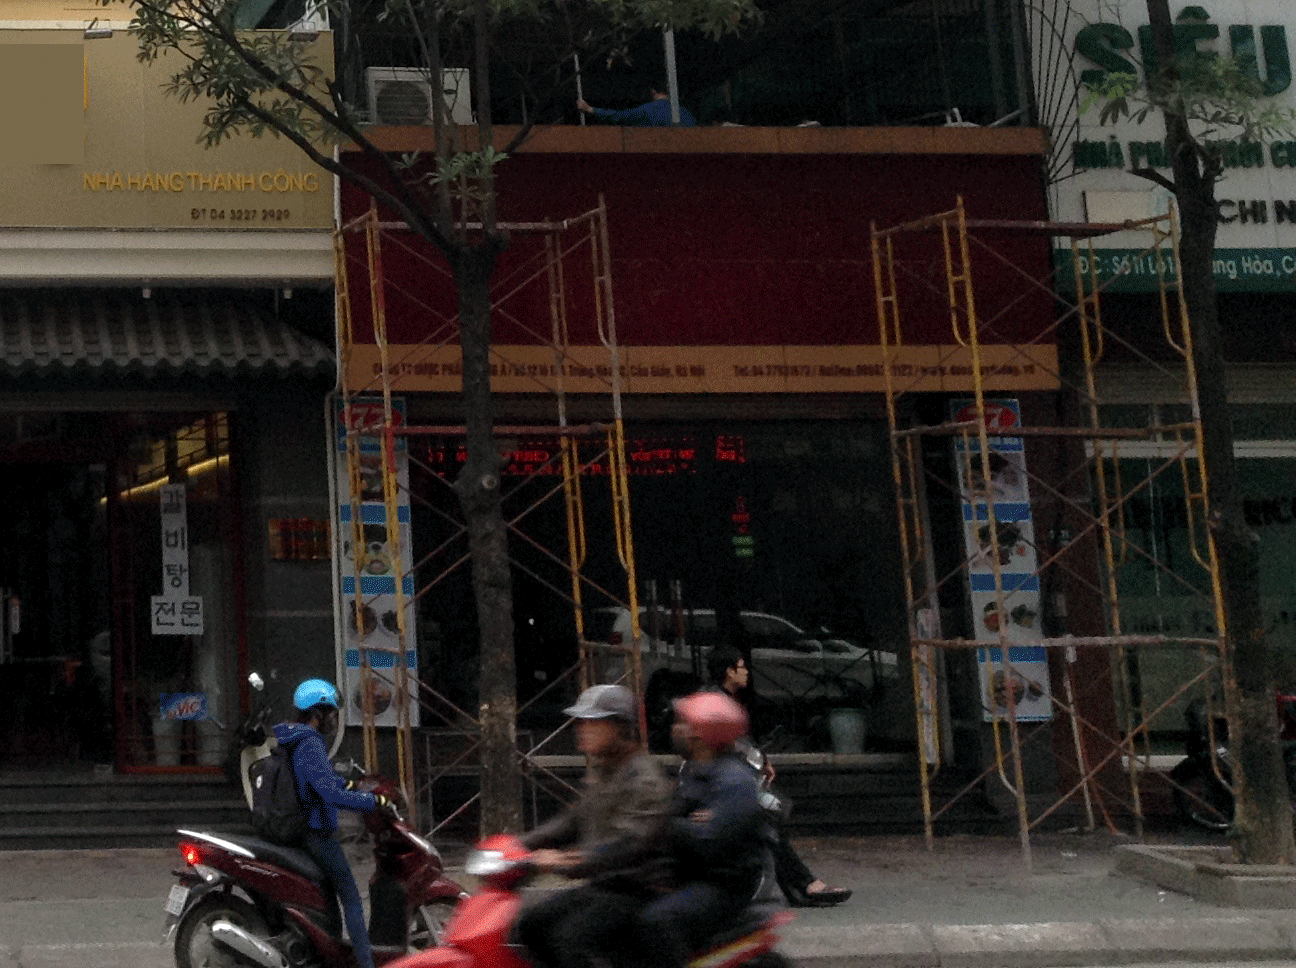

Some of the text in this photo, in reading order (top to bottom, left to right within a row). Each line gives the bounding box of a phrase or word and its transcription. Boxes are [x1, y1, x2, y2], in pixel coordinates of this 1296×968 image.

[258, 168, 320, 192] CÔNG
[210, 208, 225, 220] 04
[1217, 199, 1268, 225] CHI
[162, 488, 187, 589] 갈비탕
[154, 600, 201, 628] 전문
